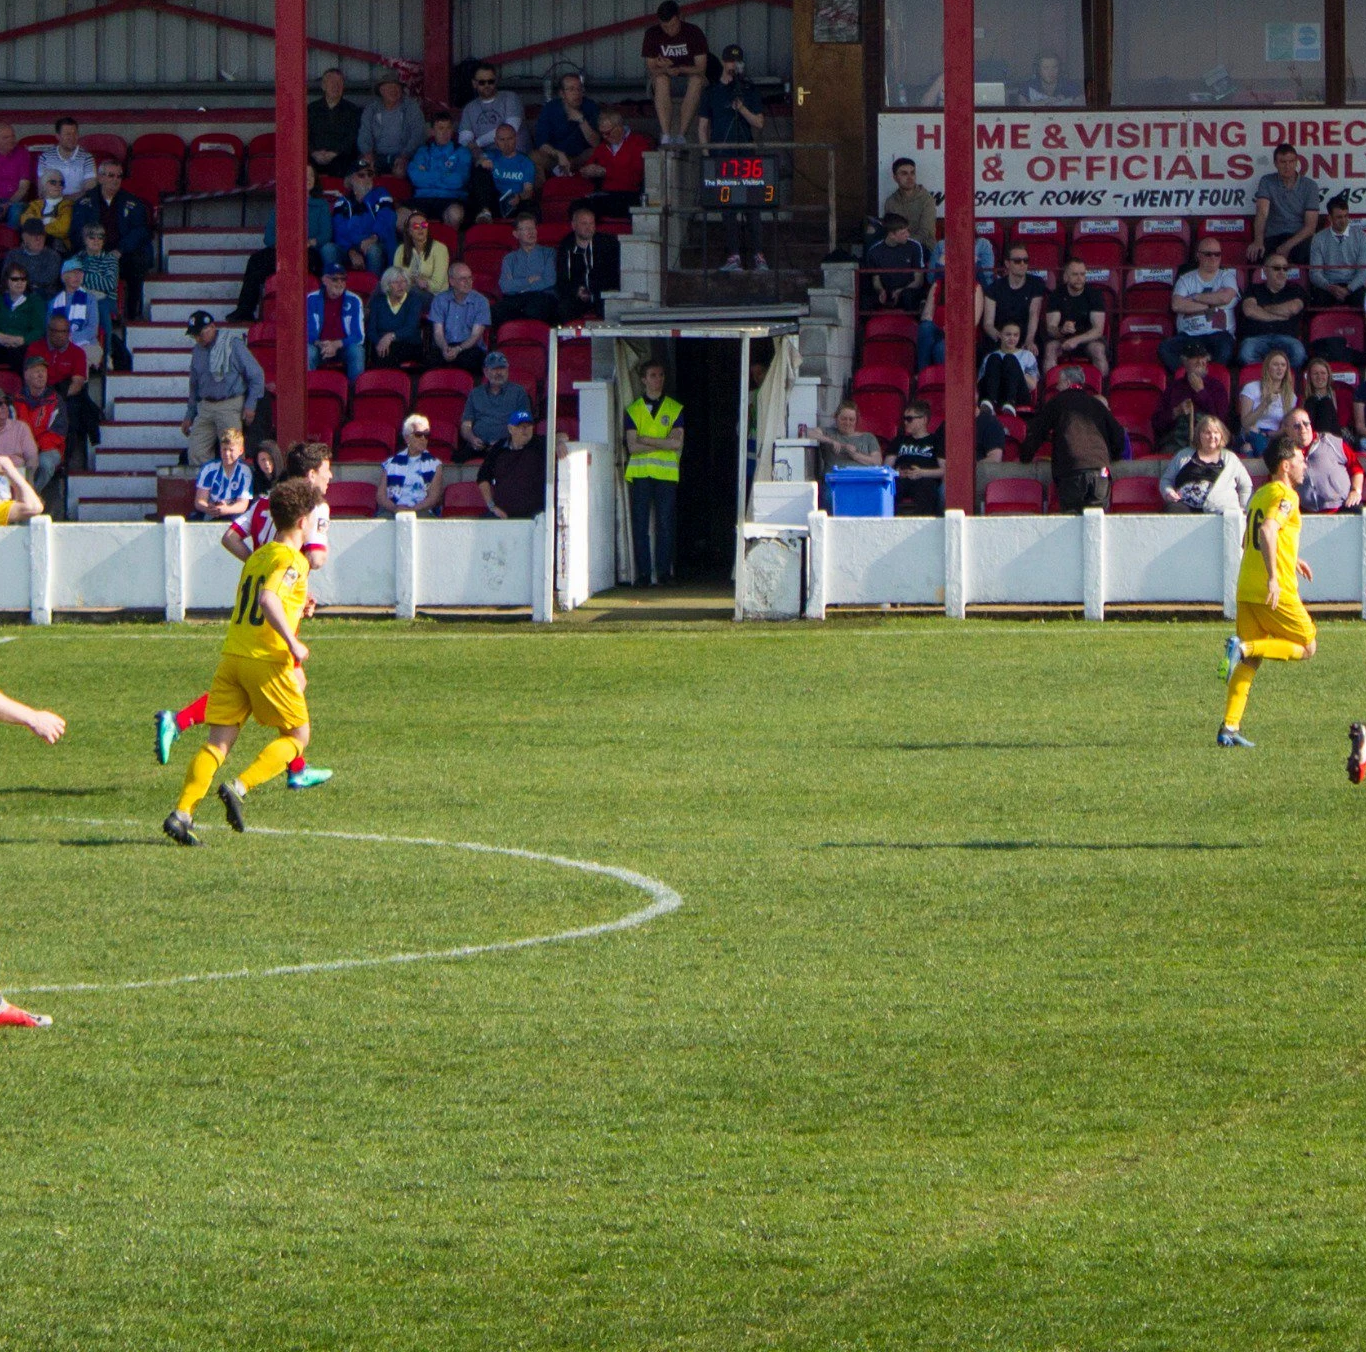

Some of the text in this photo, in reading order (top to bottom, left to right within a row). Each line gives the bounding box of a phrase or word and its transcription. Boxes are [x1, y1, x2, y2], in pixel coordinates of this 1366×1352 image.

[661, 43, 688, 57] VANS
[916, 122, 1031, 150] HME
[1041, 122, 1069, 150] &
[1073, 121, 1248, 148] VISITING
[981, 155, 1005, 182] &
[1026, 154, 1255, 181] OFFICIALS
[720, 184, 775, 203] 0 3
[1040, 189, 1107, 206] ROWS
[1198, 189, 1246, 207] FOUR
